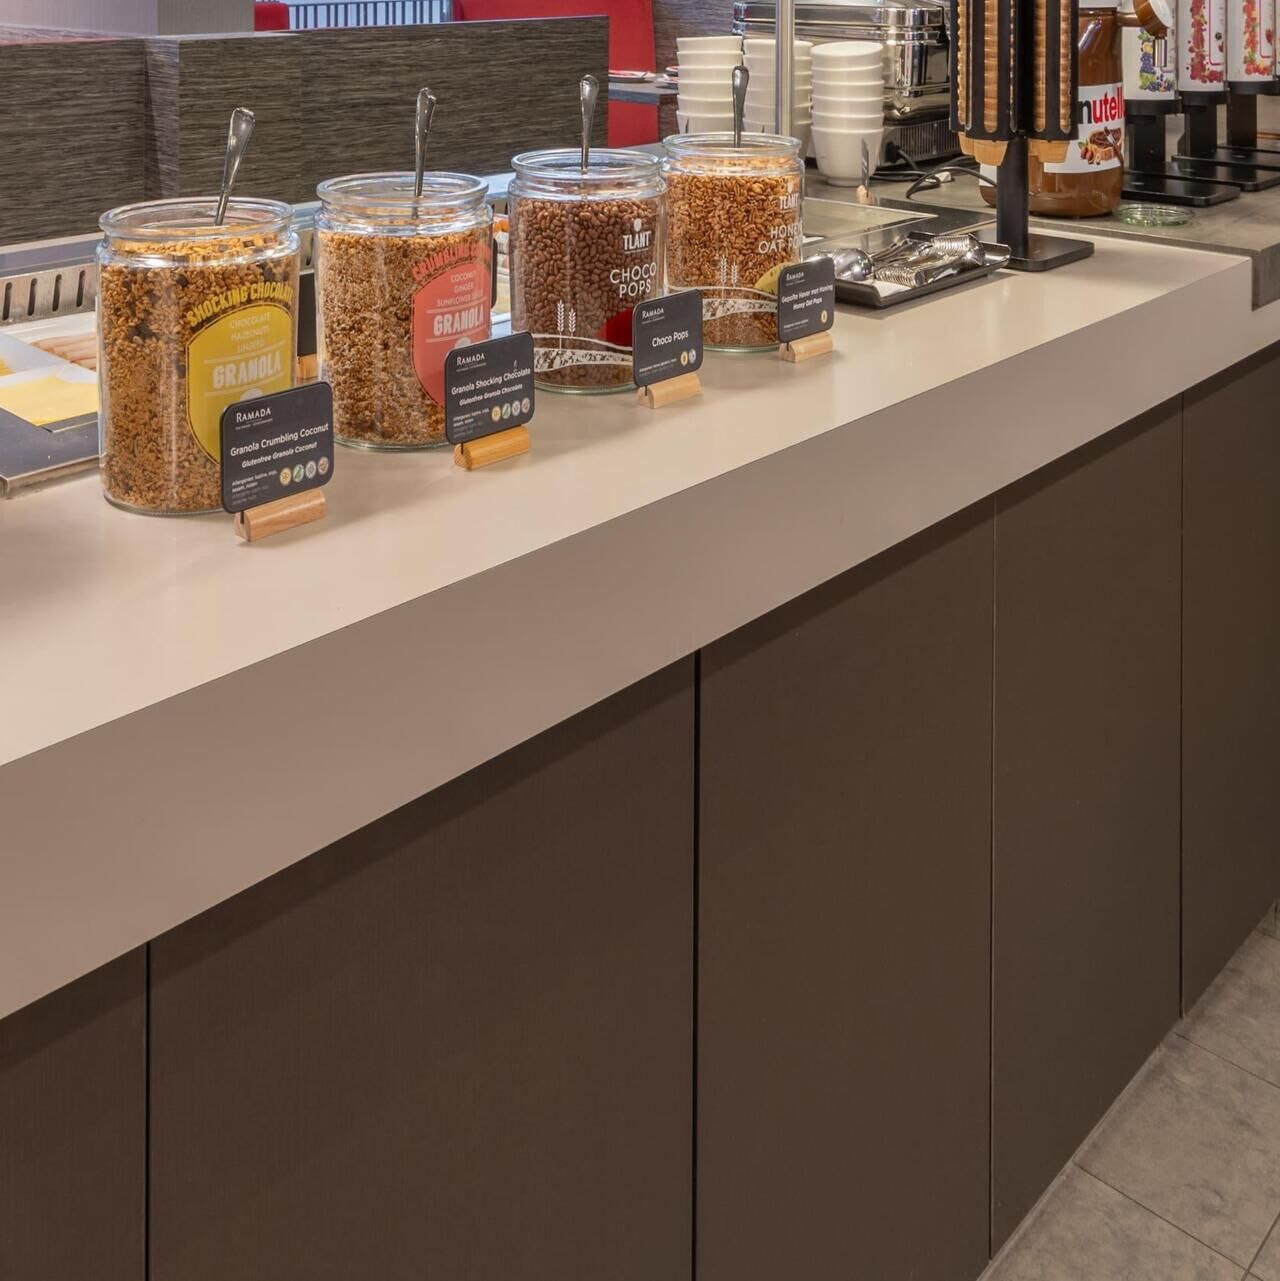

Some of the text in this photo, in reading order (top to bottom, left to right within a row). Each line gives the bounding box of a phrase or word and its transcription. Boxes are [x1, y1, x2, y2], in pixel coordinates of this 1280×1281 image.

[623, 230, 651, 250] TLANT
[759, 239, 783, 253] OAT
[610, 262, 656, 284] CHOCO
[620, 278, 651, 298] POPS
[187, 286, 248, 327] SHOCKING
[642, 308, 664, 319] RAMADA
[433, 303, 484, 336] GRANOLA
[652, 330, 688, 347] Choco Pops
[457, 353, 485, 366] RAMADA
[213, 351, 281, 389] GRANOLA
[451, 368, 531, 395] Granola Shocking Chocolate
[236, 408, 271, 423] RAMADA
[231, 423, 329, 456] Granola Crumbling Coconut
[273, 449, 294, 460] Granola
[295, 442, 318, 453] Coconut
